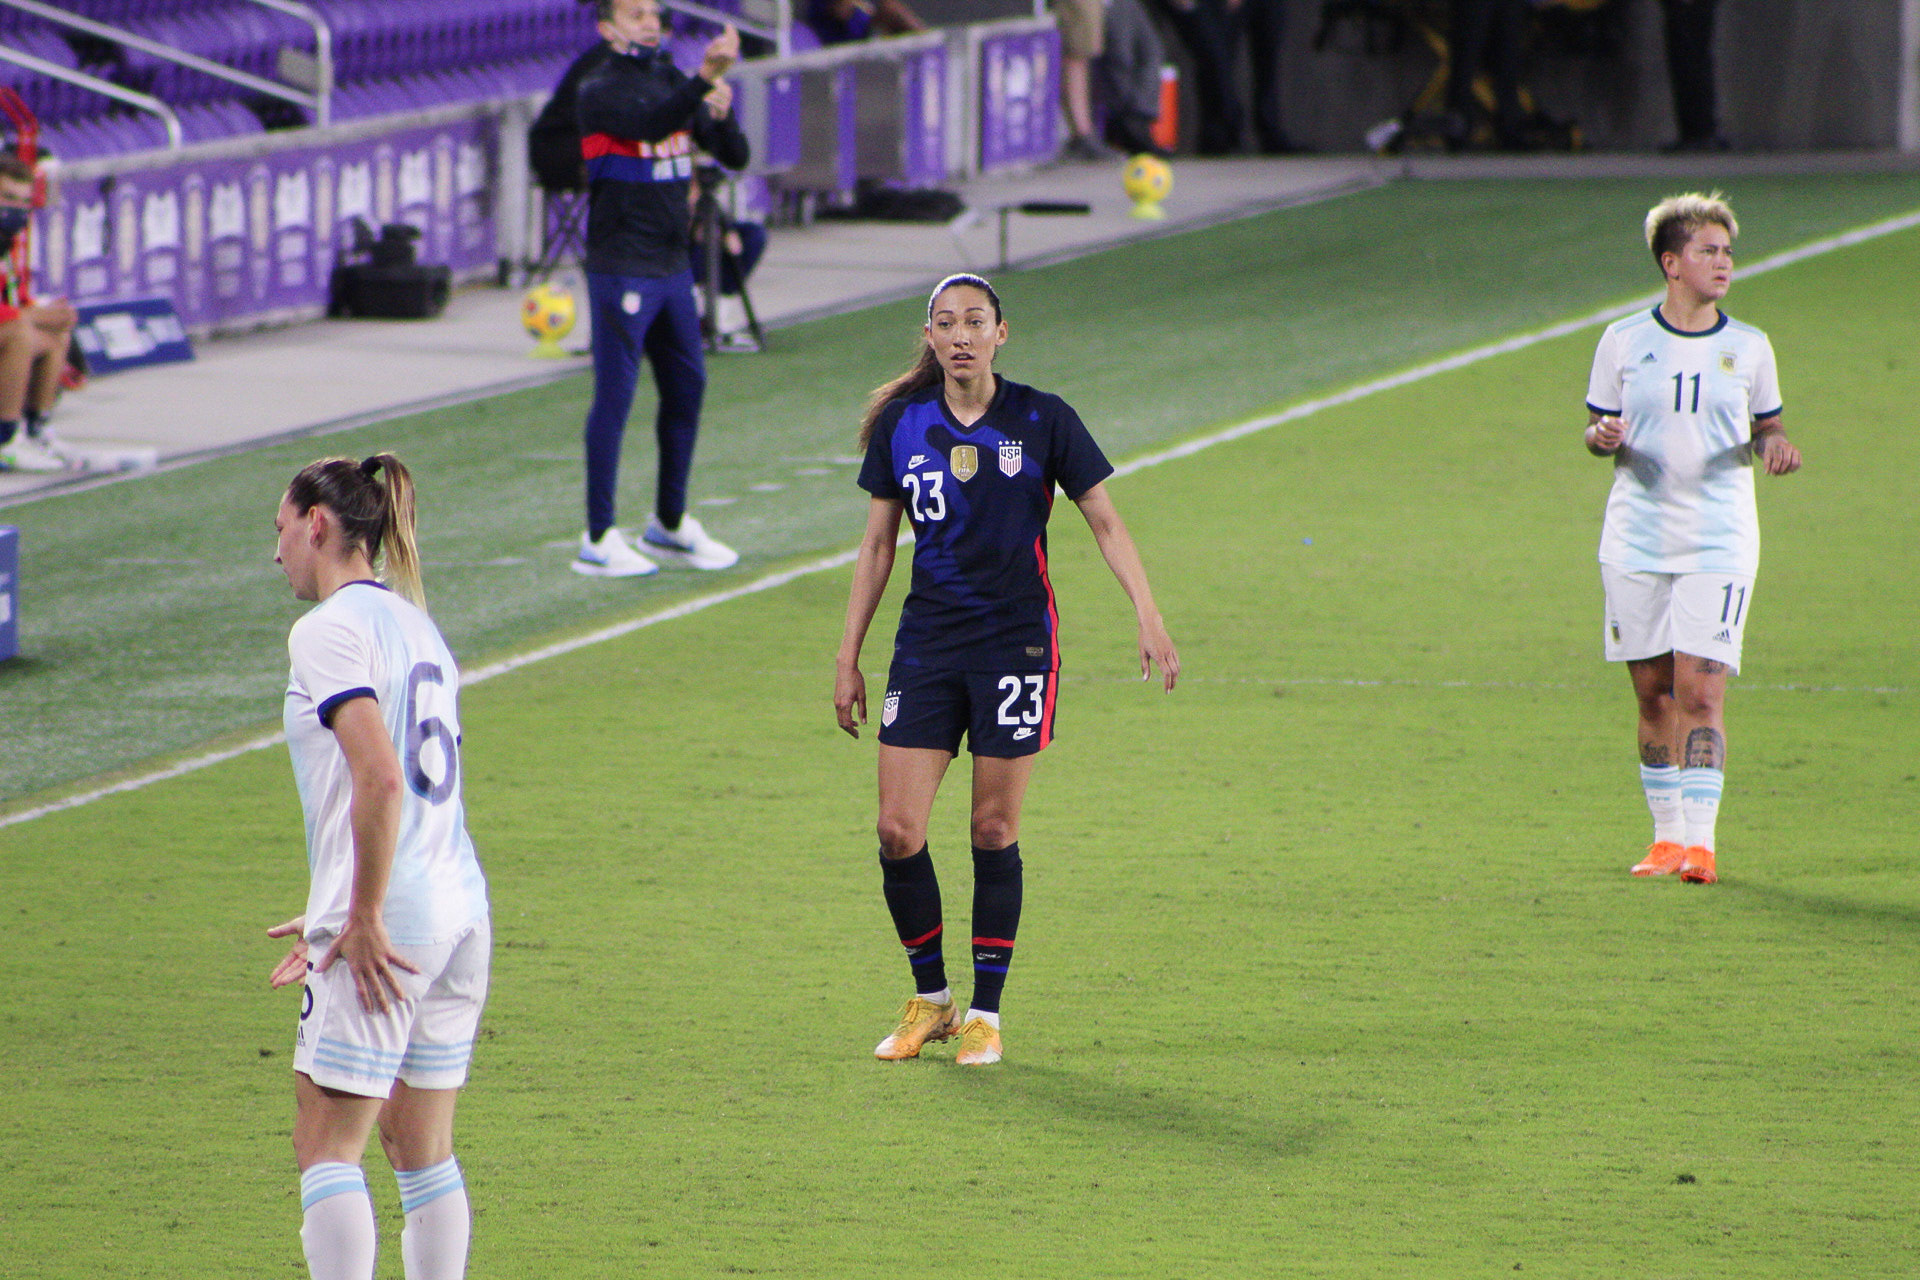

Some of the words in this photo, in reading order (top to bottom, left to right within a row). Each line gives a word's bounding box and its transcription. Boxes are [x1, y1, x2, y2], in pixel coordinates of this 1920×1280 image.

[1671, 371, 1701, 414] 11
[1001, 448, 1020, 460] USA
[902, 471, 946, 522] 23
[1720, 582, 1746, 627] 11
[997, 674, 1044, 725] 23
[404, 660, 457, 806] 6
